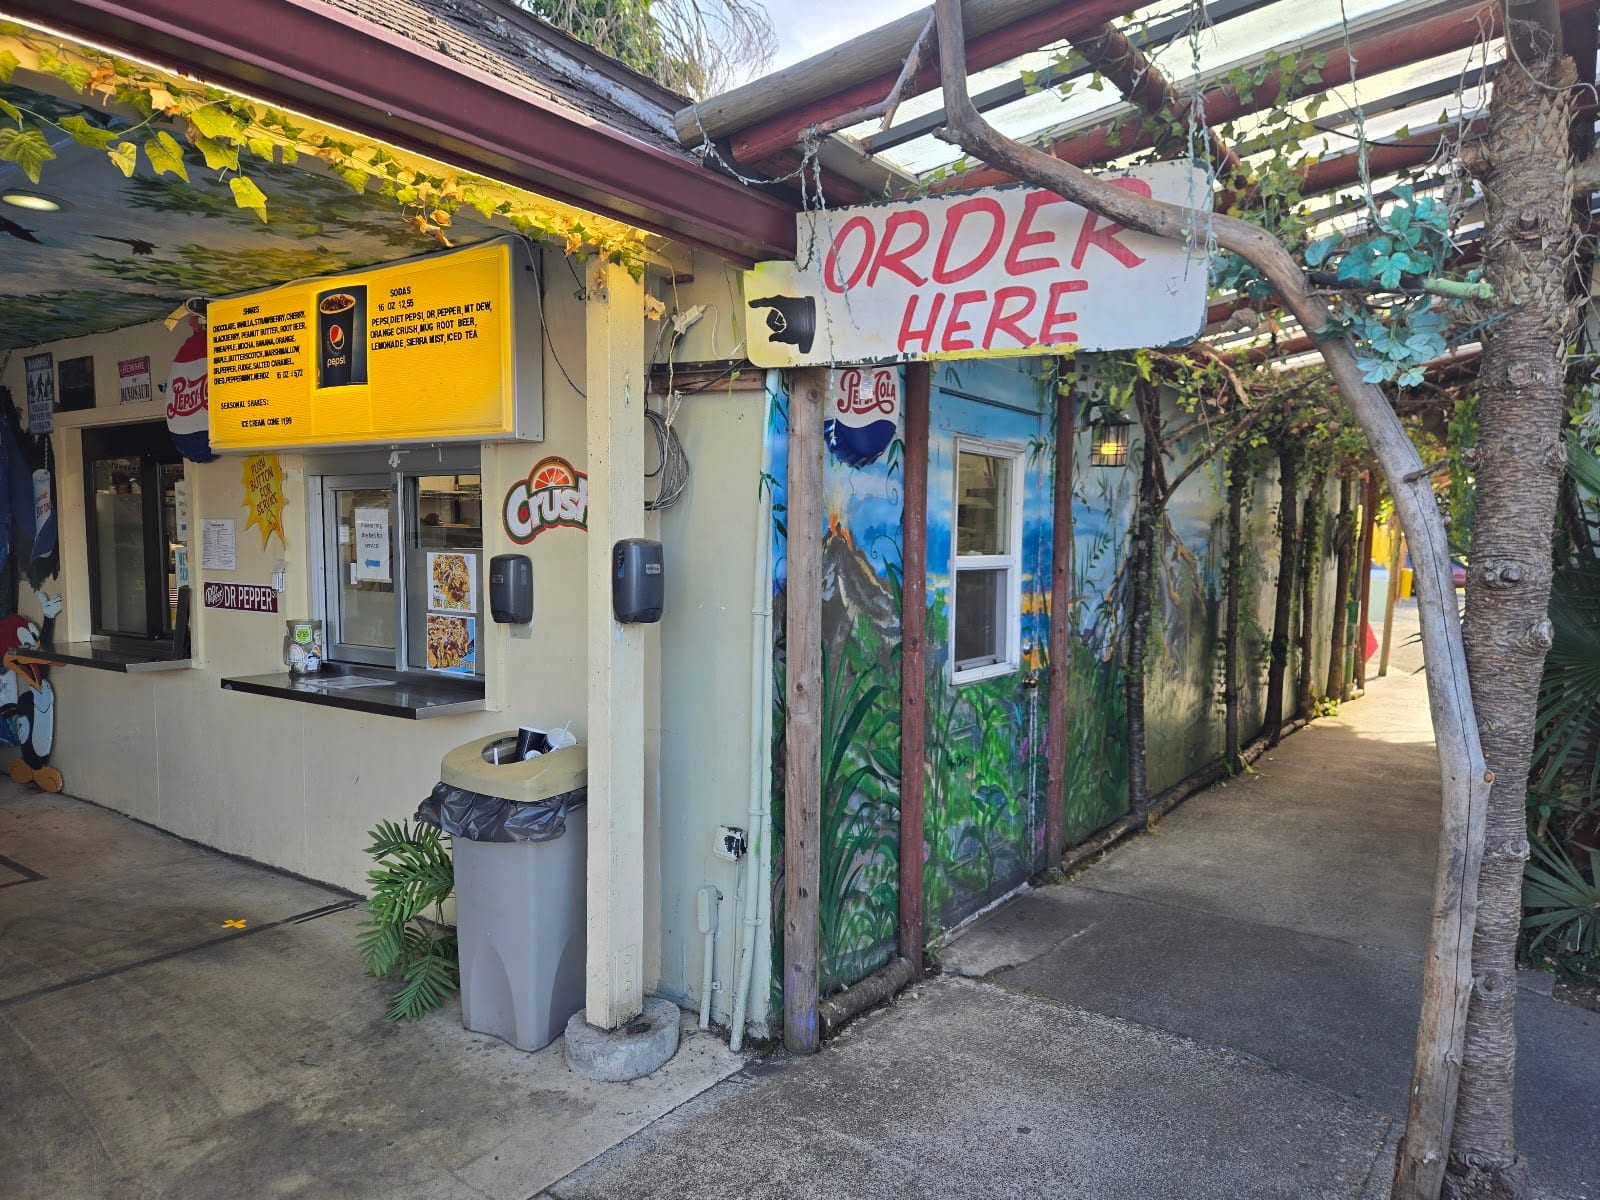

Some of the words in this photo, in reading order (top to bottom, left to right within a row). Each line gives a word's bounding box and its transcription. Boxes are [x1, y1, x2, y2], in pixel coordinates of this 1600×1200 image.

[824, 177, 1153, 293] ORDER
[390, 286, 411, 297] SODAS
[388, 302, 396, 310] OZ
[390, 314, 404, 324] DIET
[464, 304, 474, 313] MT
[898, 280, 1089, 352] HERE
[370, 328, 394, 338] ORANGE
[420, 323, 434, 332] MUG
[436, 320, 454, 330] ROOT
[406, 336, 428, 346] SIERRA
[447, 332, 462, 342] ICED
[465, 330, 478, 340] TEA
[122, 361, 145, 374] BEWARE
[327, 355, 346, 368] pepsi
[220, 400, 245, 410] SEASONAL
[250, 419, 265, 428] CREAM
[267, 418, 280, 426] CONE
[251, 457, 265, 477] PUSH
[250, 466, 274, 492] BUTTON
[260, 483, 272, 500] FOR
[257, 492, 278, 516] SERVICE
[224, 585, 236, 607] DR
[238, 587, 272, 611] PEPPER
